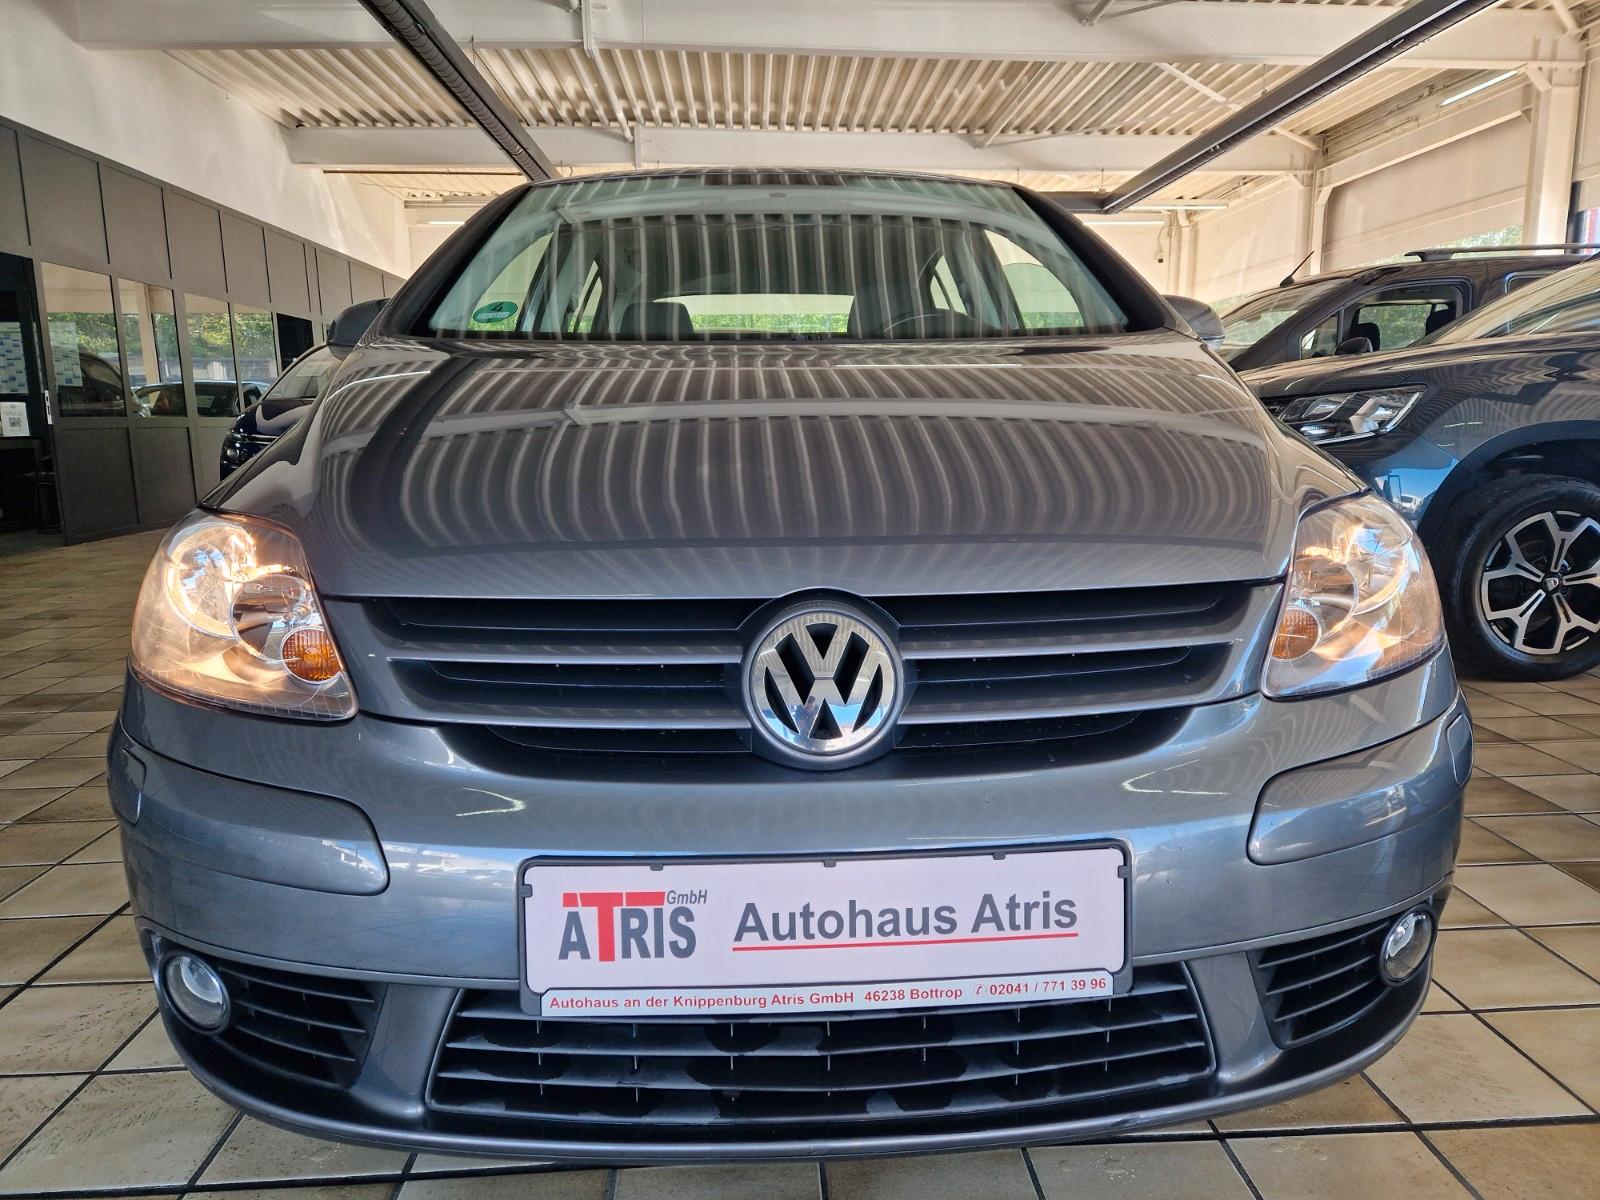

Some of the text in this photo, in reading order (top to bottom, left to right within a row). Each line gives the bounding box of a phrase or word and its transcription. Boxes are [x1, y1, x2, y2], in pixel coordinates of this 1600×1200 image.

[666, 889, 708, 905] GmbH
[733, 890, 1078, 943] Autohaus Atris
[558, 891, 697, 963] ATRIS
[549, 996, 619, 1009] Autohaus
[624, 998, 641, 1008] an
[645, 996, 668, 1008] der
[674, 994, 767, 1009] Knippenburg
[771, 993, 805, 1006] Atris
[809, 992, 854, 1005] GmbH
[864, 989, 906, 1002] 46238
[910, 987, 963, 1001] Bottrop
[989, 983, 1029, 996] 02041
[1043, 980, 1066, 992] 771
[1071, 979, 1087, 991] 39
[1090, 978, 1106, 990] 96
